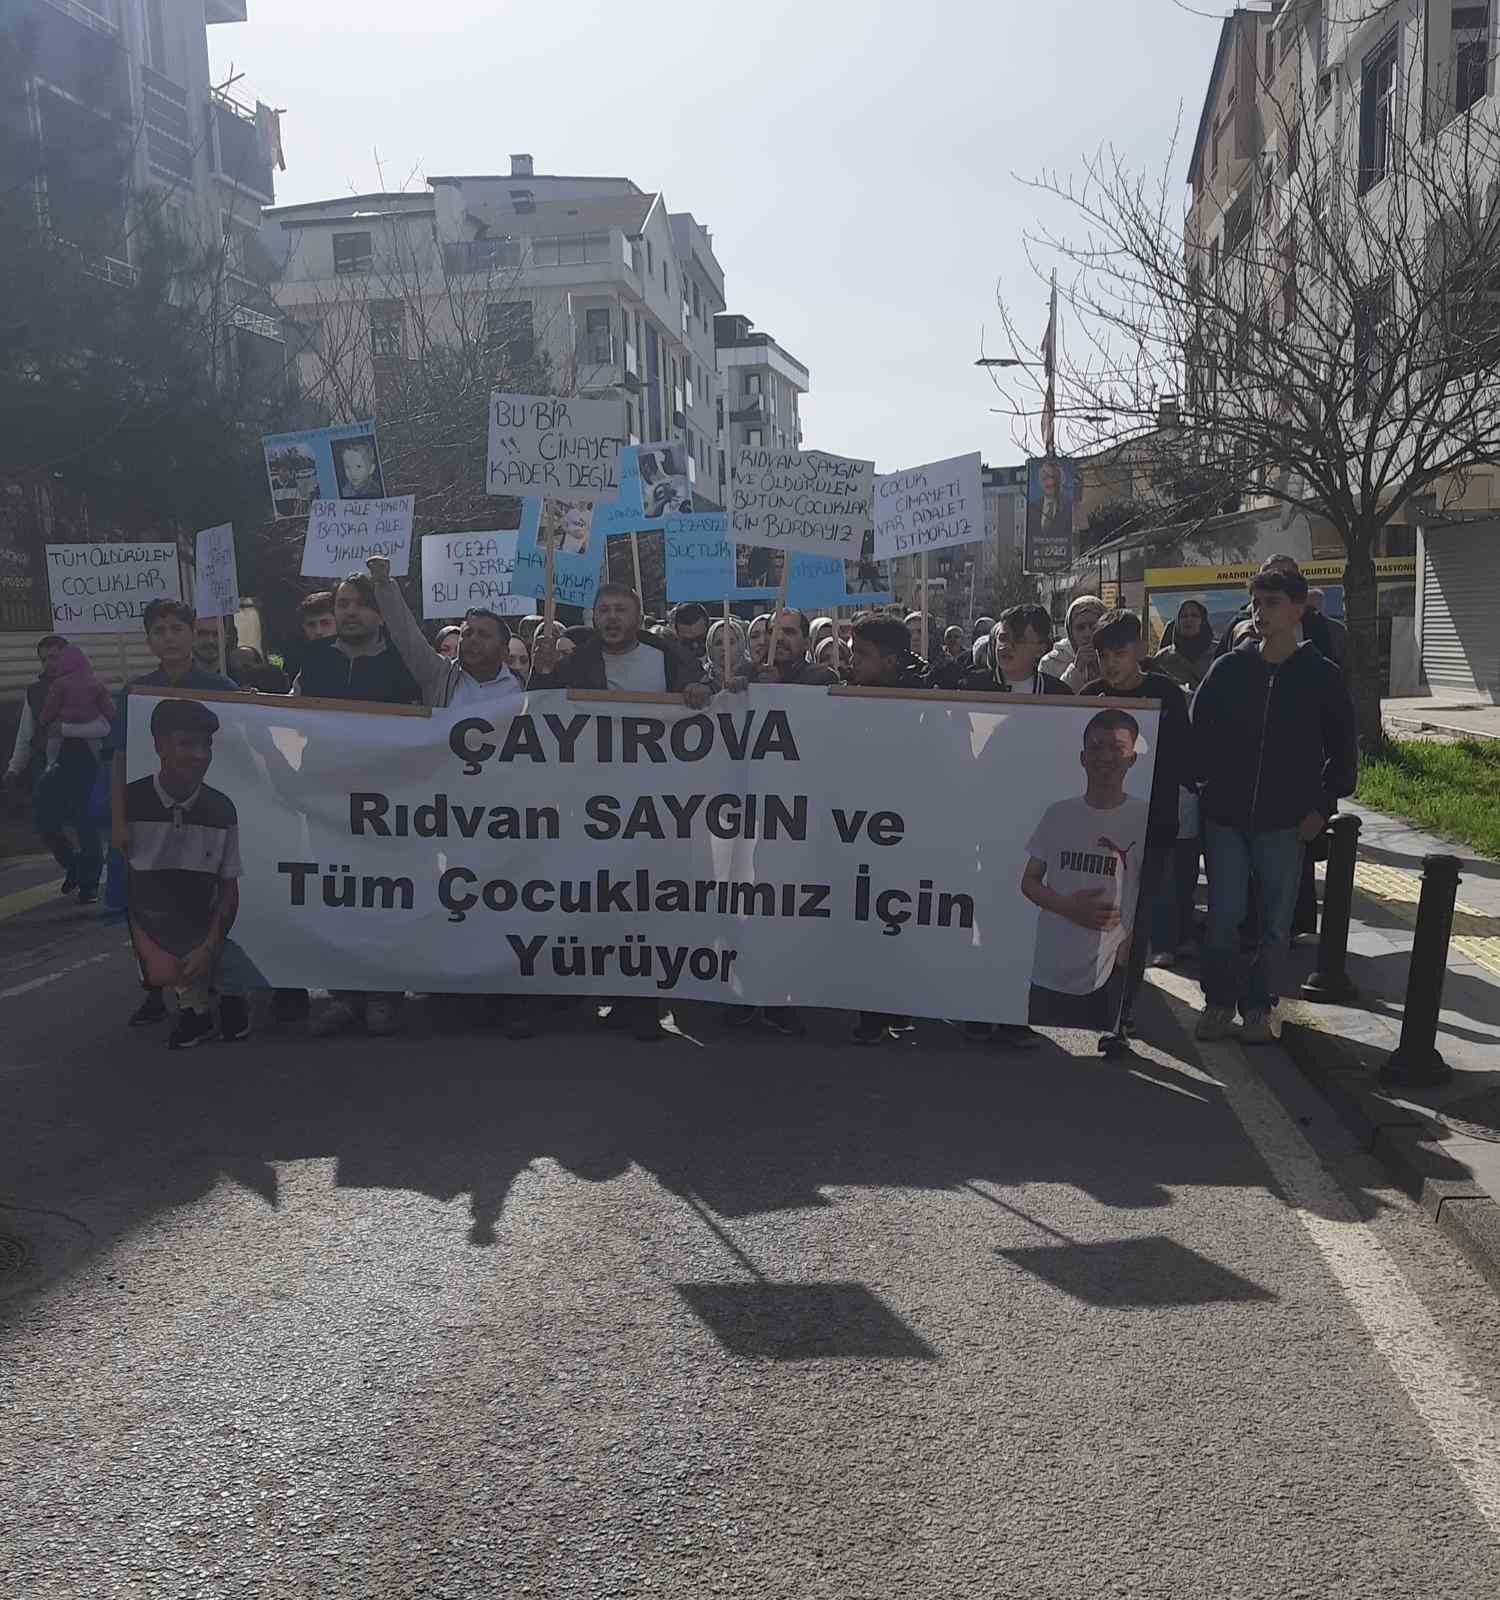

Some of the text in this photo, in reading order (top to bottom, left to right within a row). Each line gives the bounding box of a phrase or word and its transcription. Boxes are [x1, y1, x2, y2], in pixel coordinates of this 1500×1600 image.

[496, 399, 573, 430] BU BİR
[490, 460, 561, 487] KADER
[740, 449, 864, 481] RIDVAN SAYGIN
[763, 513, 853, 541] BURDAYIZ
[877, 497, 968, 536] VAR ADALET
[48, 548, 87, 567] TÜM
[517, 551, 545, 568] HA
[432, 582, 459, 602] BU
[448, 709, 801, 776] ÇAYIROVA
[350, 792, 905, 846] Rıdvan SAYGIN ve
[1060, 850, 1118, 877] PUMA
[277, 862, 975, 936] Tüm Çocuklarımız İçin
[505, 934, 738, 990] Yürüyor
